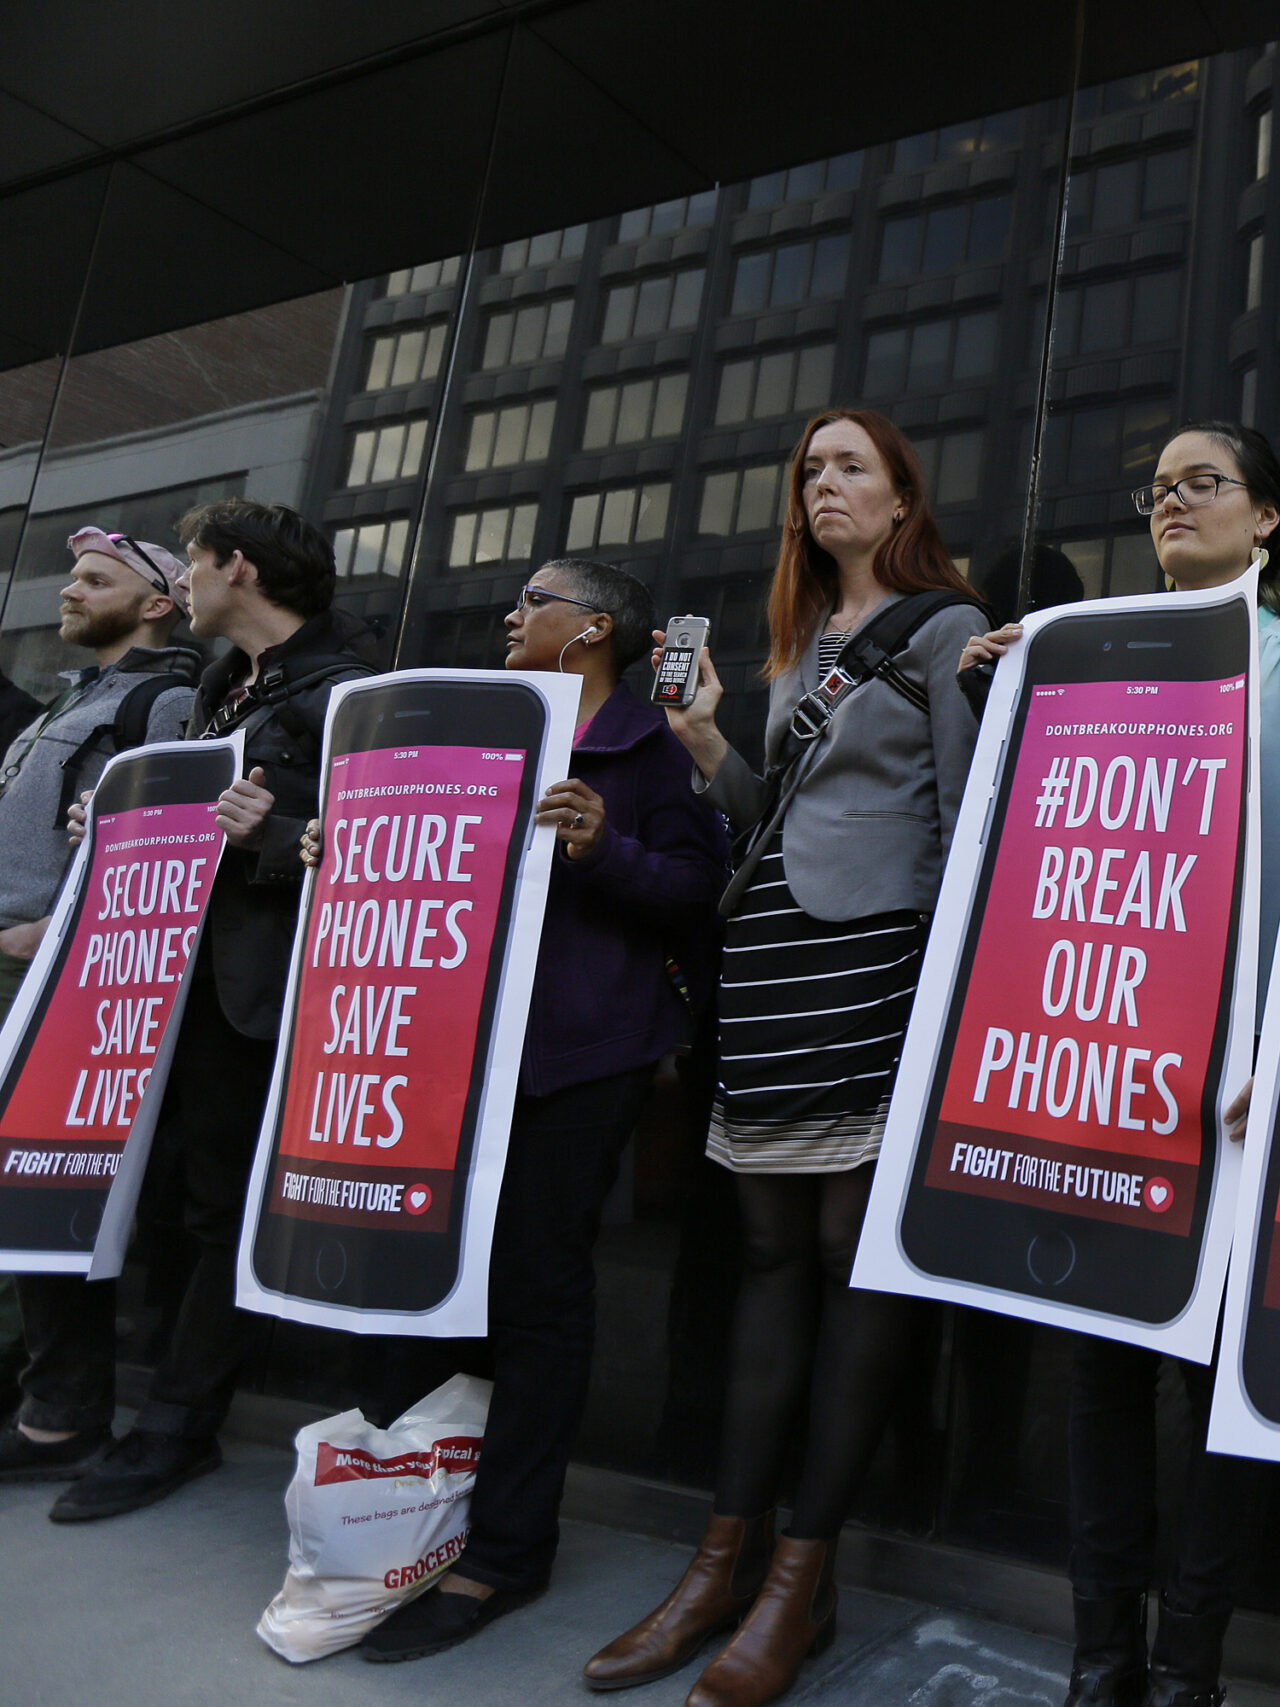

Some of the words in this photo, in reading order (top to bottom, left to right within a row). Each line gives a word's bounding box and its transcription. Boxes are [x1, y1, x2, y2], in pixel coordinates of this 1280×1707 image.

[662, 662, 690, 671] CONSENT
[669, 652, 678, 661] DO
[679, 653, 692, 662] NOT
[1126, 686, 1144, 694] 5:30
[1145, 686, 1158, 695] PM
[1220, 683, 1234, 693] 100%
[1046, 722, 1233, 736] DONTBREAKOURPHONES.ORG
[337, 784, 498, 801] DONTBREAKOURPHONES.ORG
[105, 832, 216, 853] DONTBREAKOURPHONES.ORG
[329, 814, 482, 885] SECURE
[98, 858, 206, 920] SECURE
[1032, 846, 1198, 933] BREAK
[312, 899, 473, 970] PHONES
[1042, 938, 1148, 1028] OUR
[91, 997, 163, 1056] SAVE
[323, 985, 416, 1057] SAVE
[308, 1071, 408, 1149] LIVES
[972, 1027, 1183, 1136] PHONES
[4, 1150, 66, 1175] FIGHT
[950, 1142, 1014, 1181] FIGHT
[1063, 1164, 1144, 1207] FUTURE
[282, 1172, 310, 1201] FIGHT
[341, 1181, 405, 1212] FUTURE
[336, 1453, 371, 1470] More
[372, 1463, 405, 1474] than
[342, 1515, 372, 1525] These
[374, 1509, 398, 1520] bags
[400, 1506, 416, 1515] are
[384, 1532, 464, 1589] GROCERY
